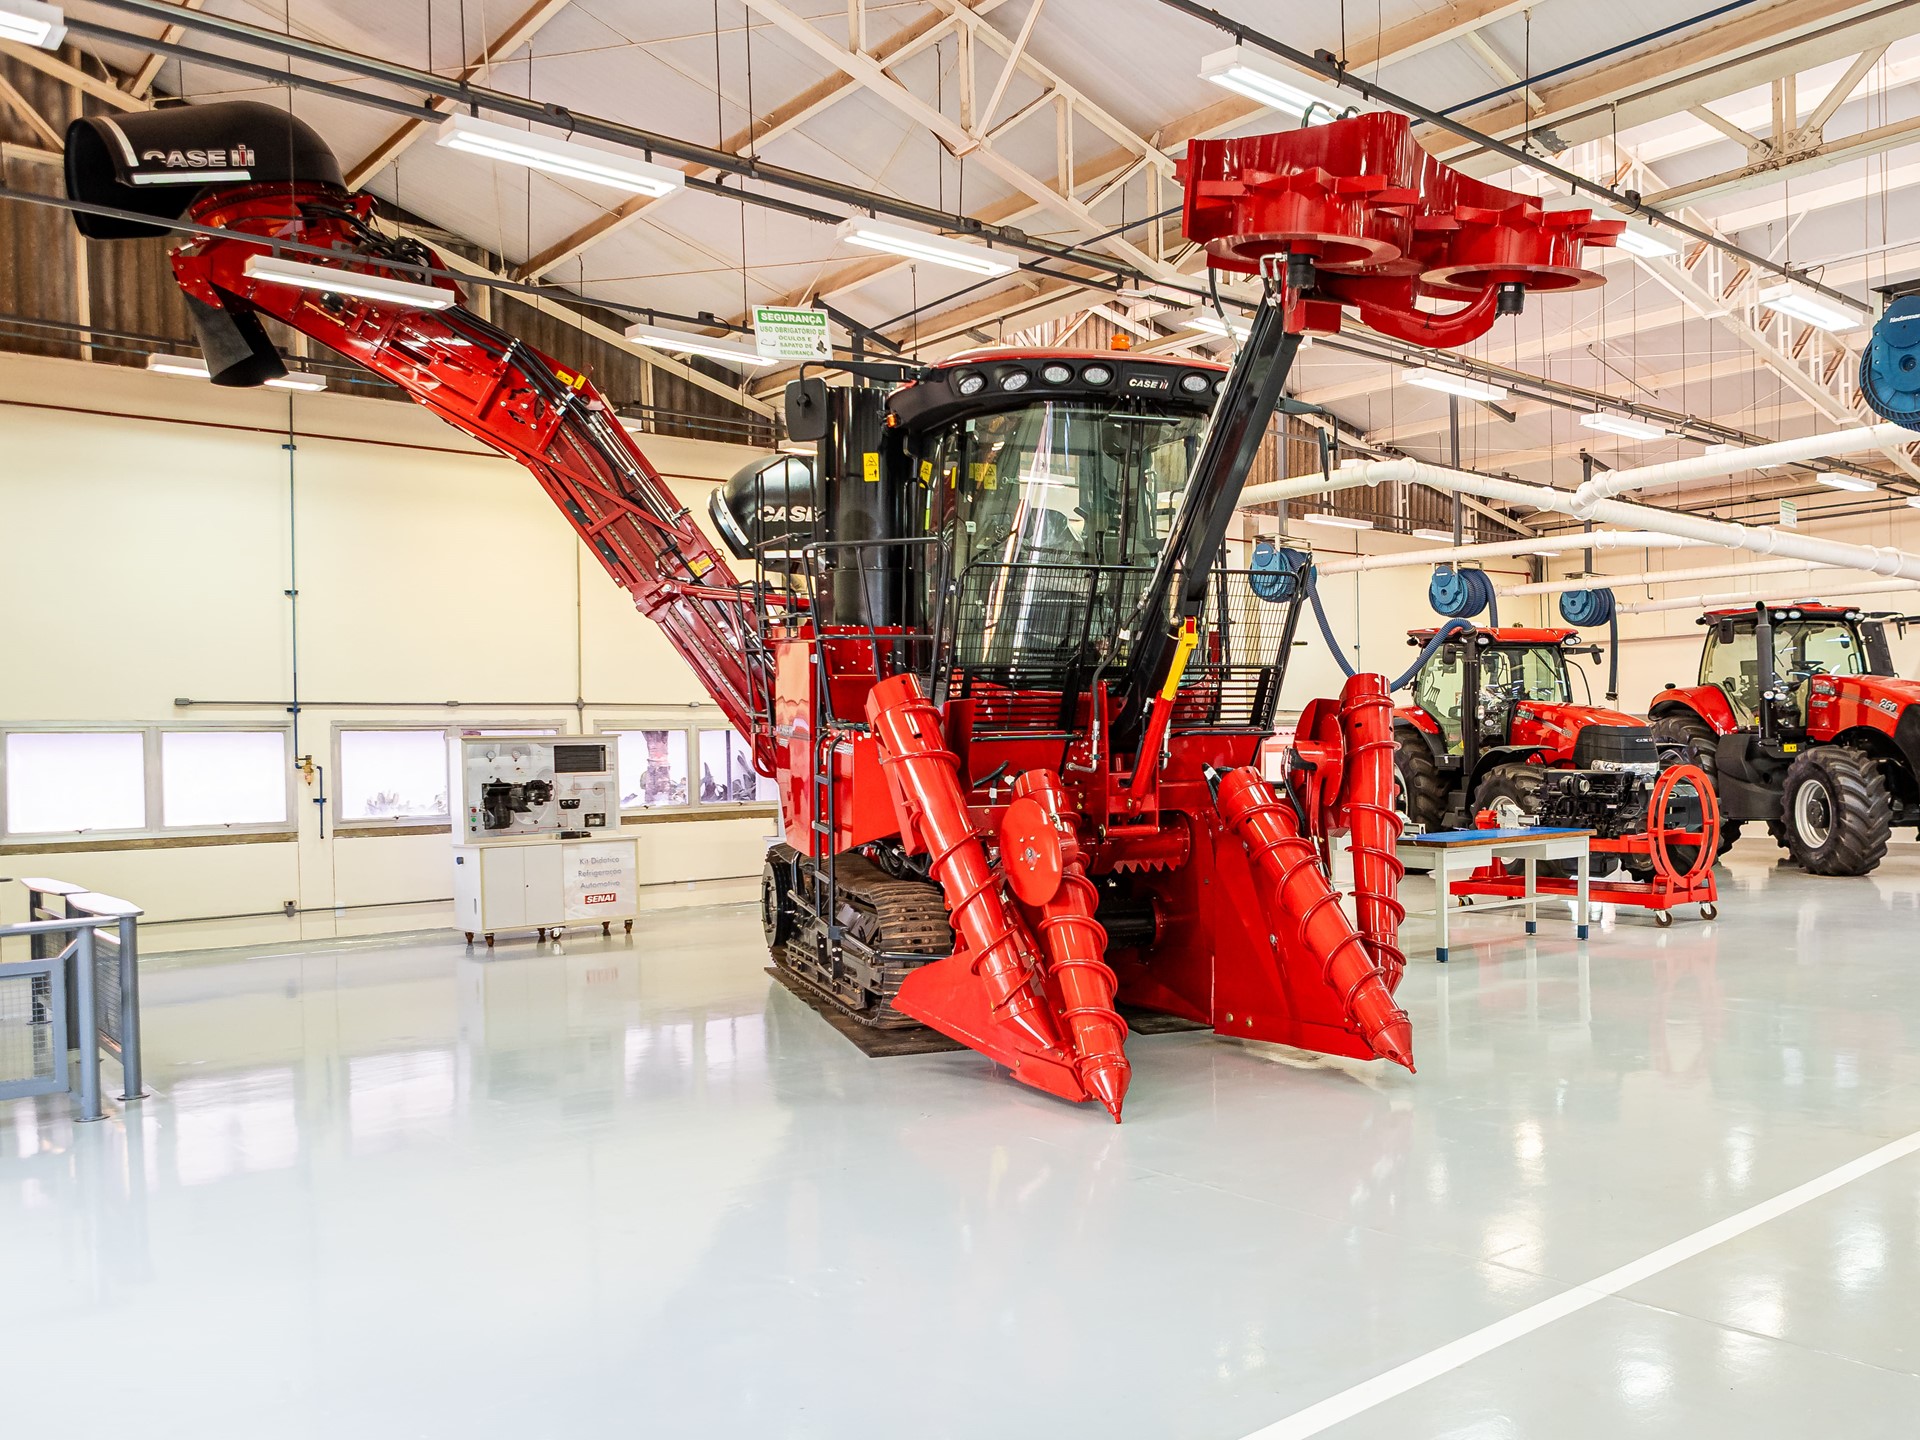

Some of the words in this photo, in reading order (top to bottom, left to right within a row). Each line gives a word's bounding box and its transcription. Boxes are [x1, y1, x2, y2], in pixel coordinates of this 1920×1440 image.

[761, 313, 822, 325] SEGURANÇA
[1129, 379, 1158, 388] CASE
[587, 894, 614, 903] SENAI
